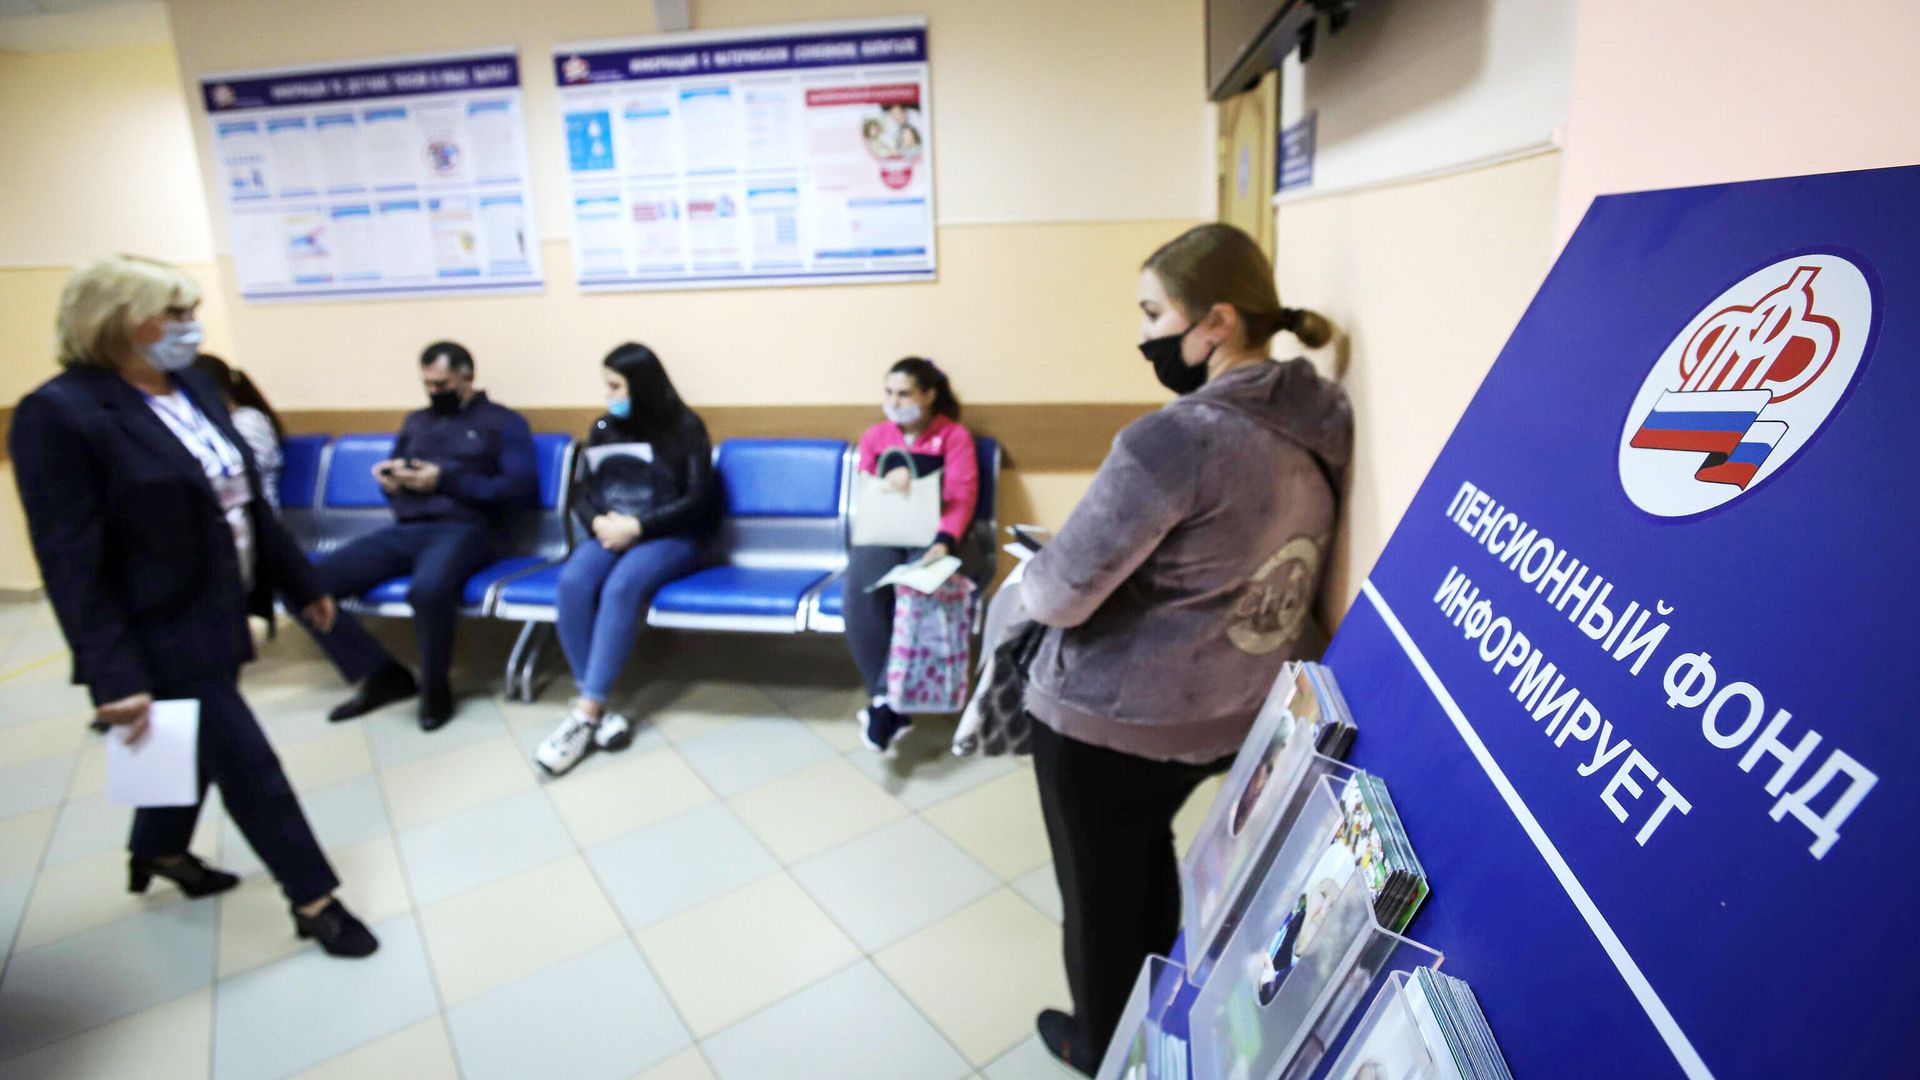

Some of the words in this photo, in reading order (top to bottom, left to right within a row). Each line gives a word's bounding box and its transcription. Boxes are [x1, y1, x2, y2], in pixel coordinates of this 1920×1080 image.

[1433, 565, 1693, 848] ИНФОРМИРУЕТ
[1445, 480, 1675, 677] ПЕНСИОННЫЙ
[1662, 651, 1879, 861] ФОНД
